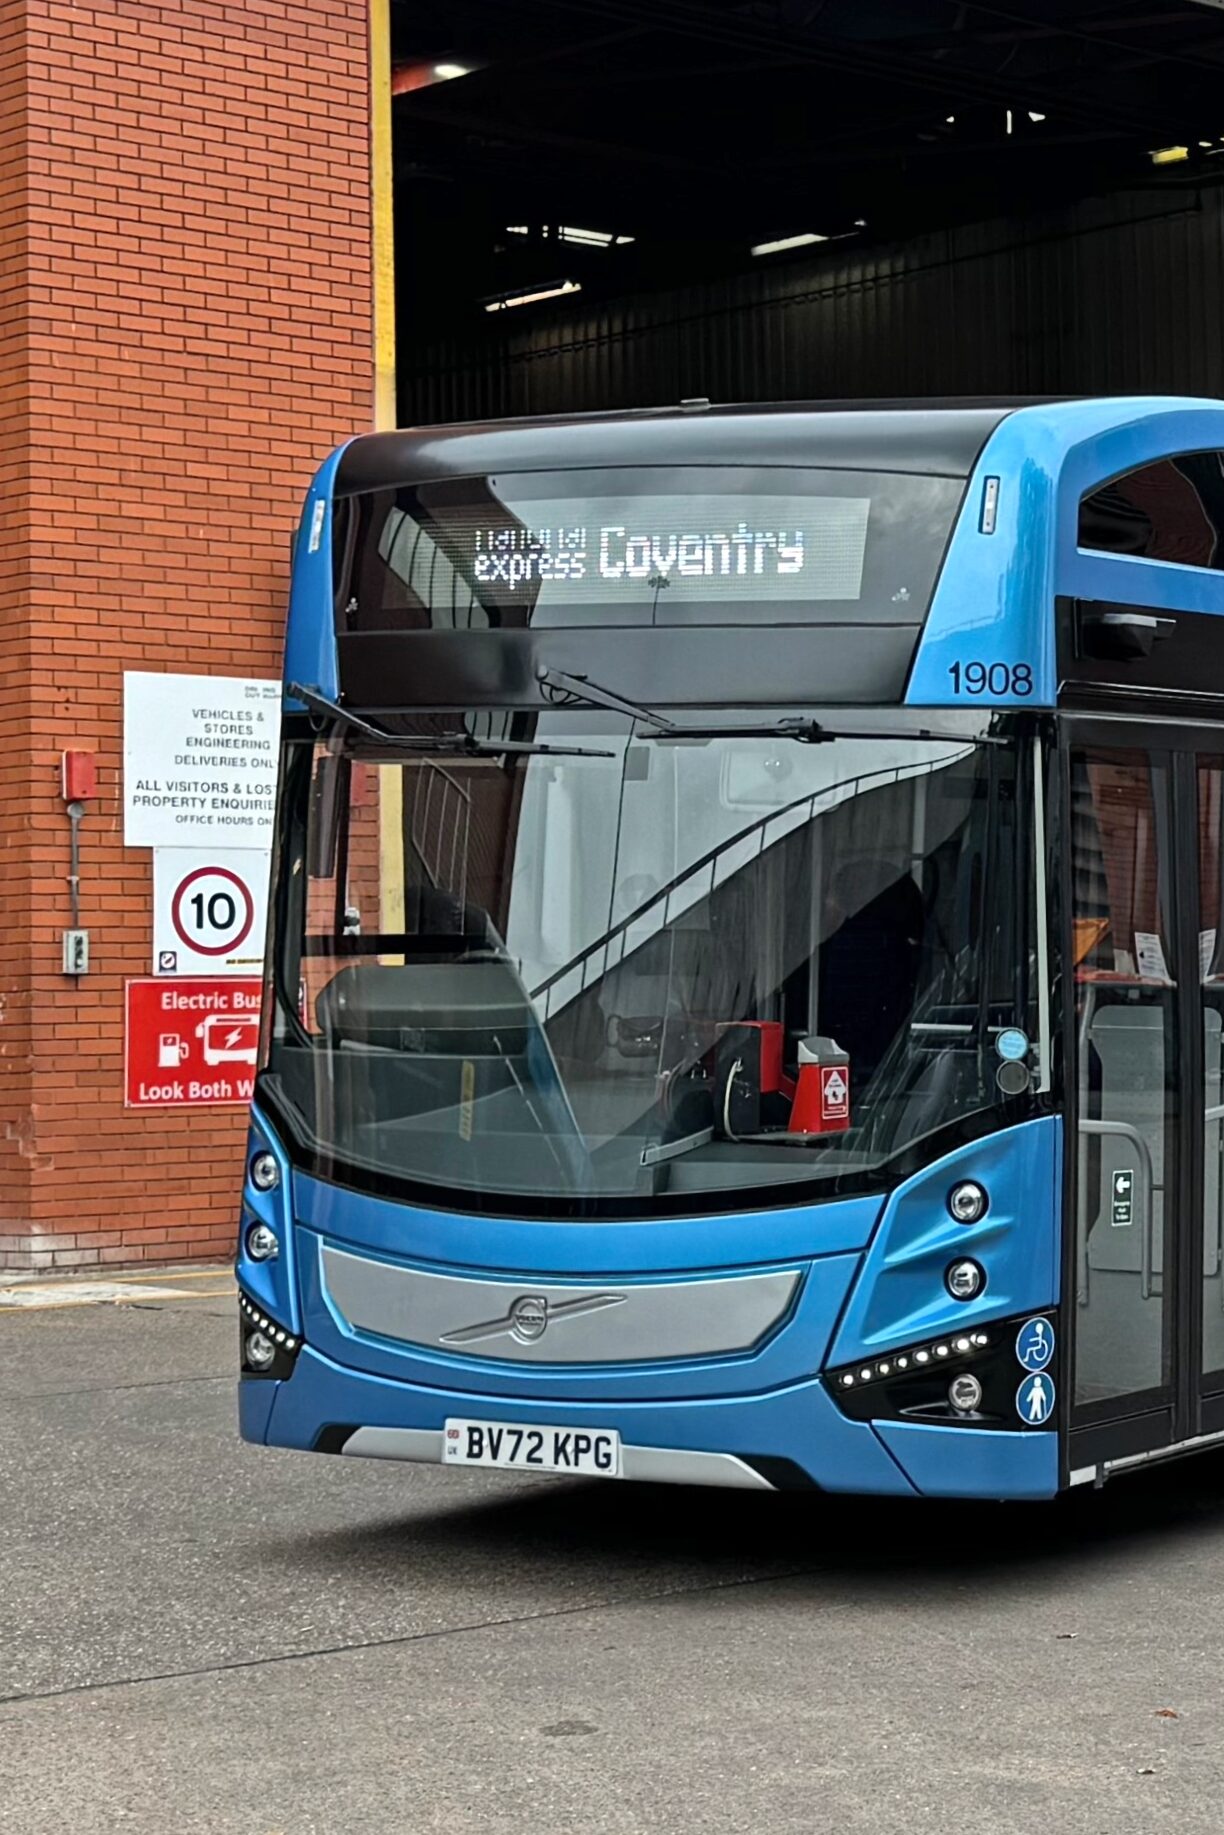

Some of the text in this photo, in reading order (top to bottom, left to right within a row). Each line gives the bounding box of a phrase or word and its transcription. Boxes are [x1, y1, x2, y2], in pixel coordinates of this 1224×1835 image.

[600, 522, 804, 578] Coventry
[474, 552, 586, 590] express
[948, 660, 1033, 696] 1908
[192, 709, 264, 722] VEHICLES &
[204, 723, 253, 735] STORES
[186, 737, 271, 750] ENGINEERING
[174, 755, 276, 769] DELIVERIES ONL
[136, 780, 161, 791] ALL
[166, 781, 228, 794] VISITORS
[232, 783, 241, 794] &
[133, 795, 275, 811] PROPERTY ENQUIRIE
[175, 814, 213, 825] OFFICE
[217, 815, 253, 826] HOURS
[191, 892, 236, 930] 10
[161, 991, 228, 1010] Electric
[139, 1081, 184, 1100] Look
[189, 1080, 232, 1098] Both
[466, 1426, 612, 1469] BV72 KPG
